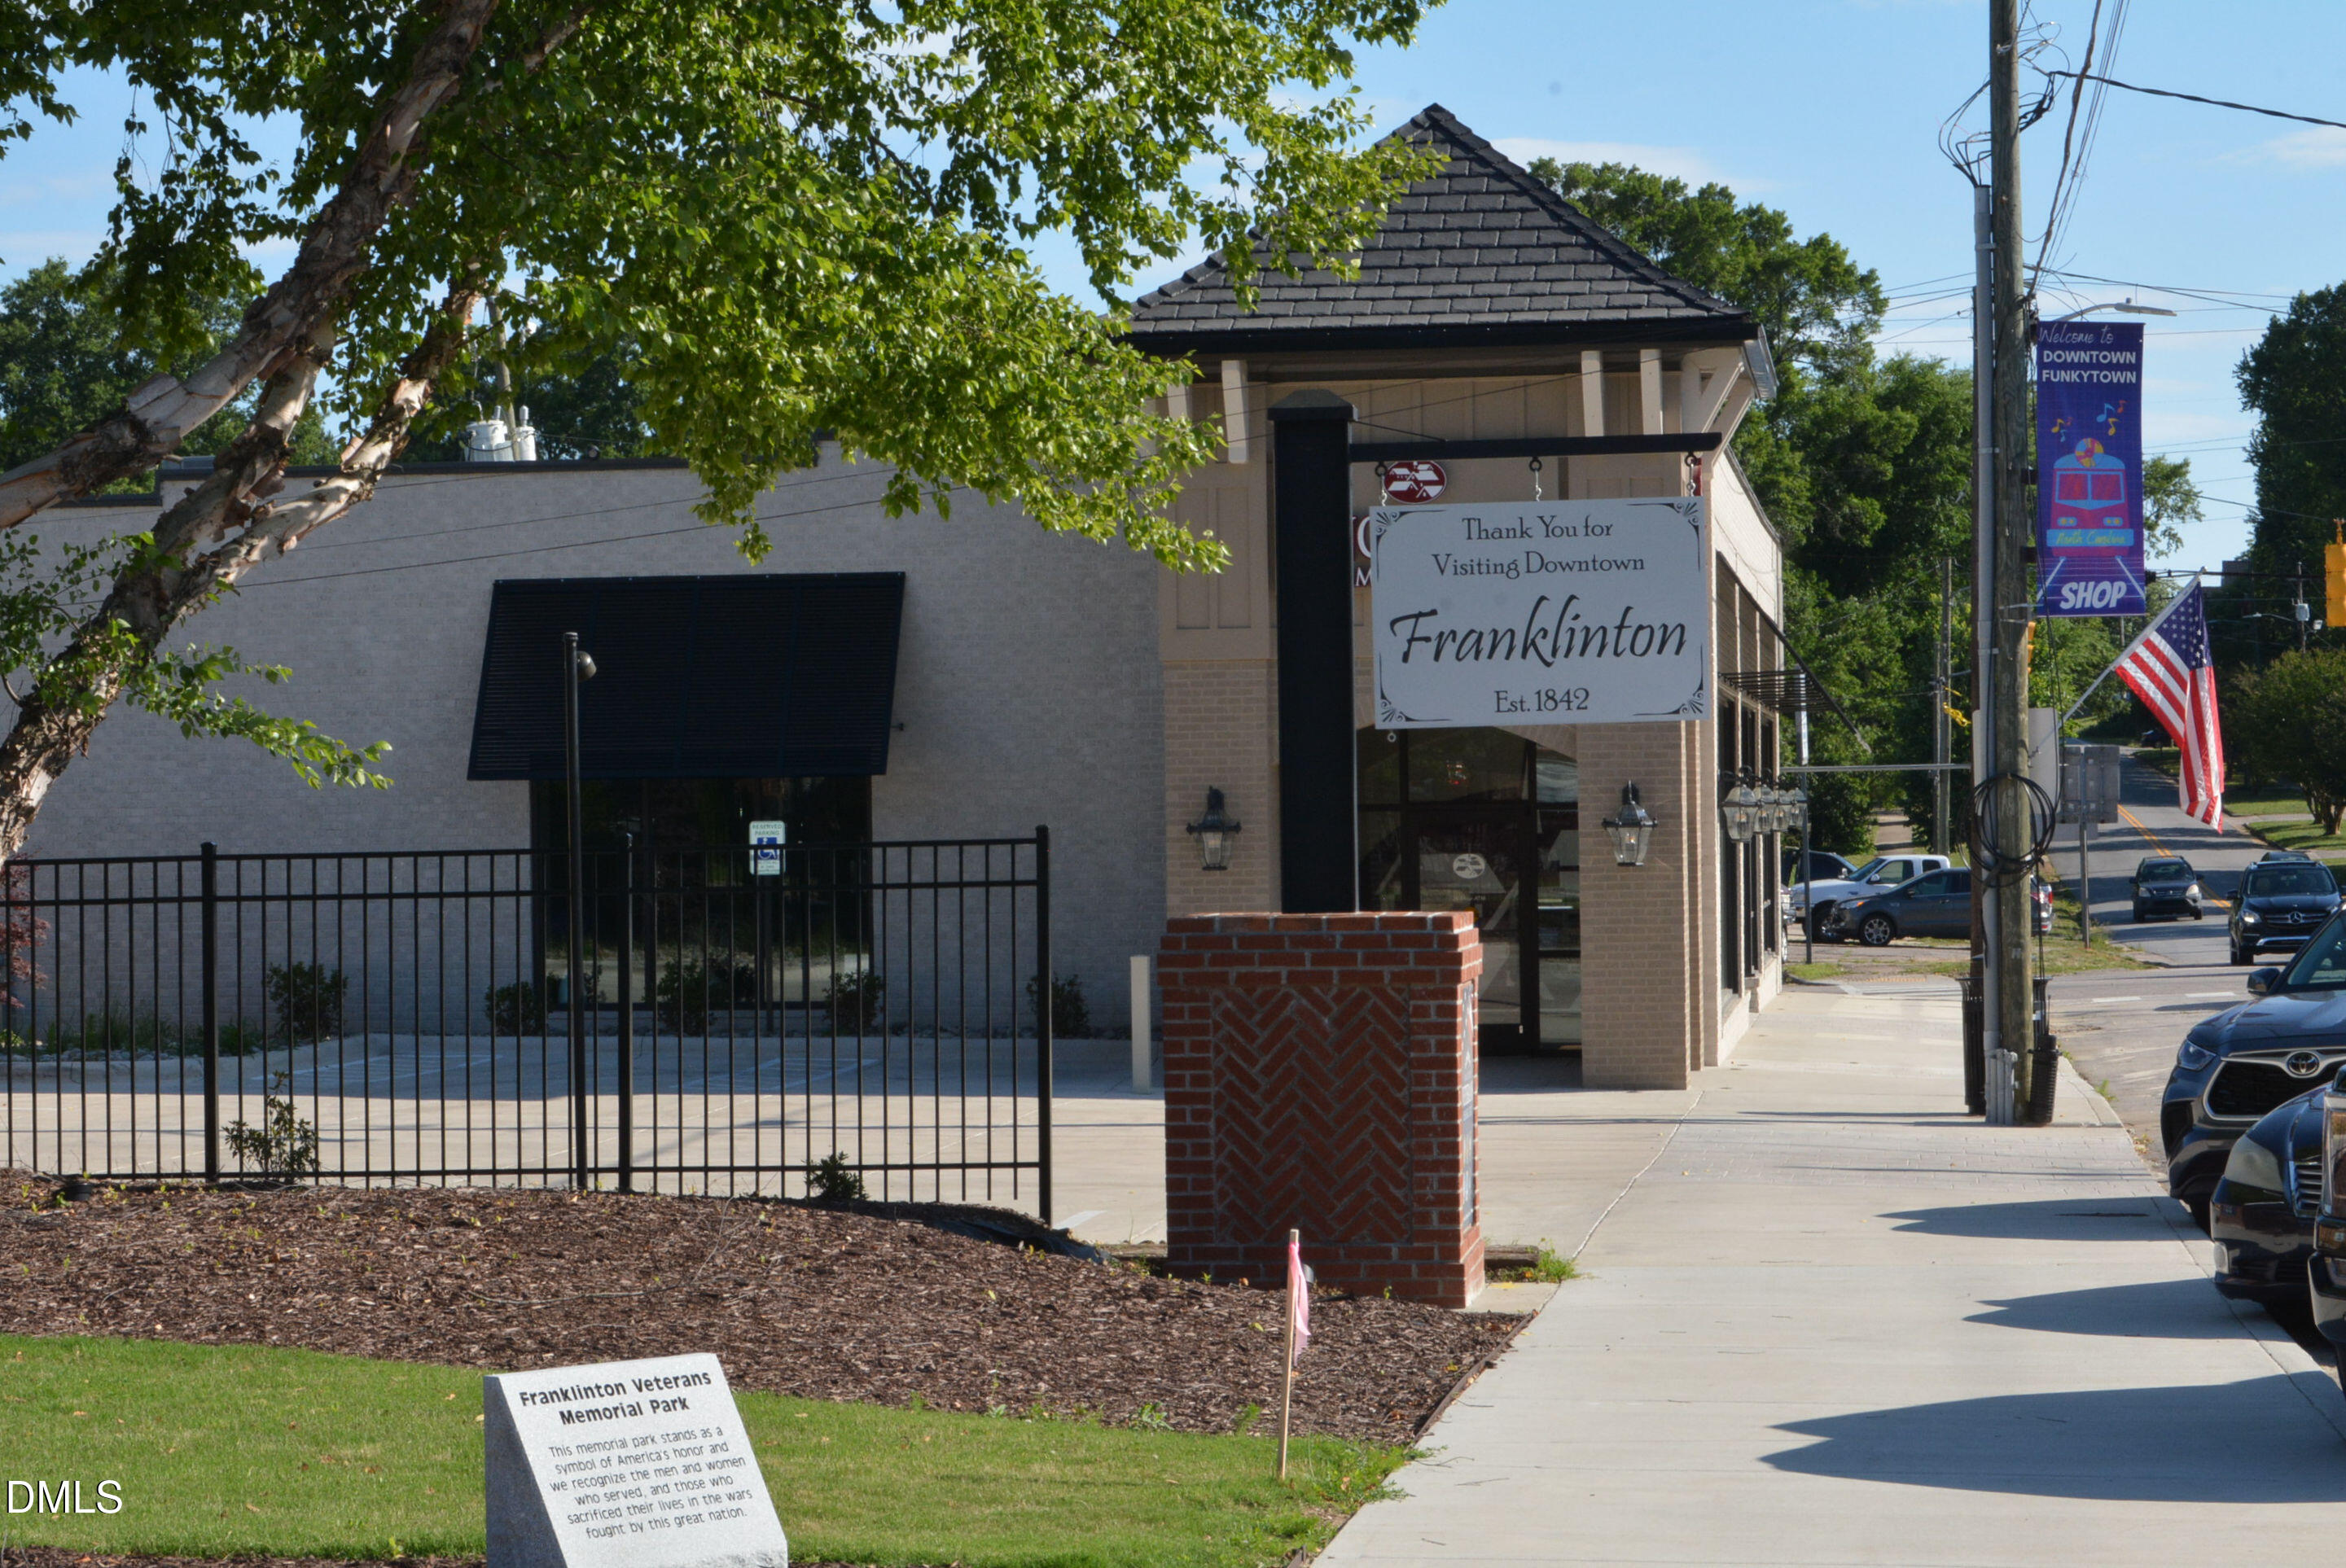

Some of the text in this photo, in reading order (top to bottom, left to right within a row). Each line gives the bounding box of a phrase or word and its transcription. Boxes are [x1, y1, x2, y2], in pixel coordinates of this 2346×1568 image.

[2039, 323, 2113, 344] Welcome to
[2043, 350, 2136, 363] DOWNTOWN
[2042, 370, 2136, 383] FUNKYTOWN
[1462, 515, 1613, 541] Thank You for
[1432, 551, 1645, 580] Visiting Downtown
[2059, 580, 2127, 609] SHOP
[1389, 594, 1686, 668] Franklinton
[1494, 688, 1590, 713] Est. 1842
[519, 1371, 711, 1407] Franklinton Veterans
[559, 1396, 689, 1426] Memorial Park
[549, 1427, 723, 1458] This memorial park stands as a
[555, 1441, 729, 1475] symbol of America's honor and
[550, 1456, 746, 1492] we recognize the men and women
[575, 1475, 733, 1506] who served, and those who
[568, 1488, 752, 1524] sacrificed their lives in the wars
[586, 1506, 747, 1540] fought by this great nation.
